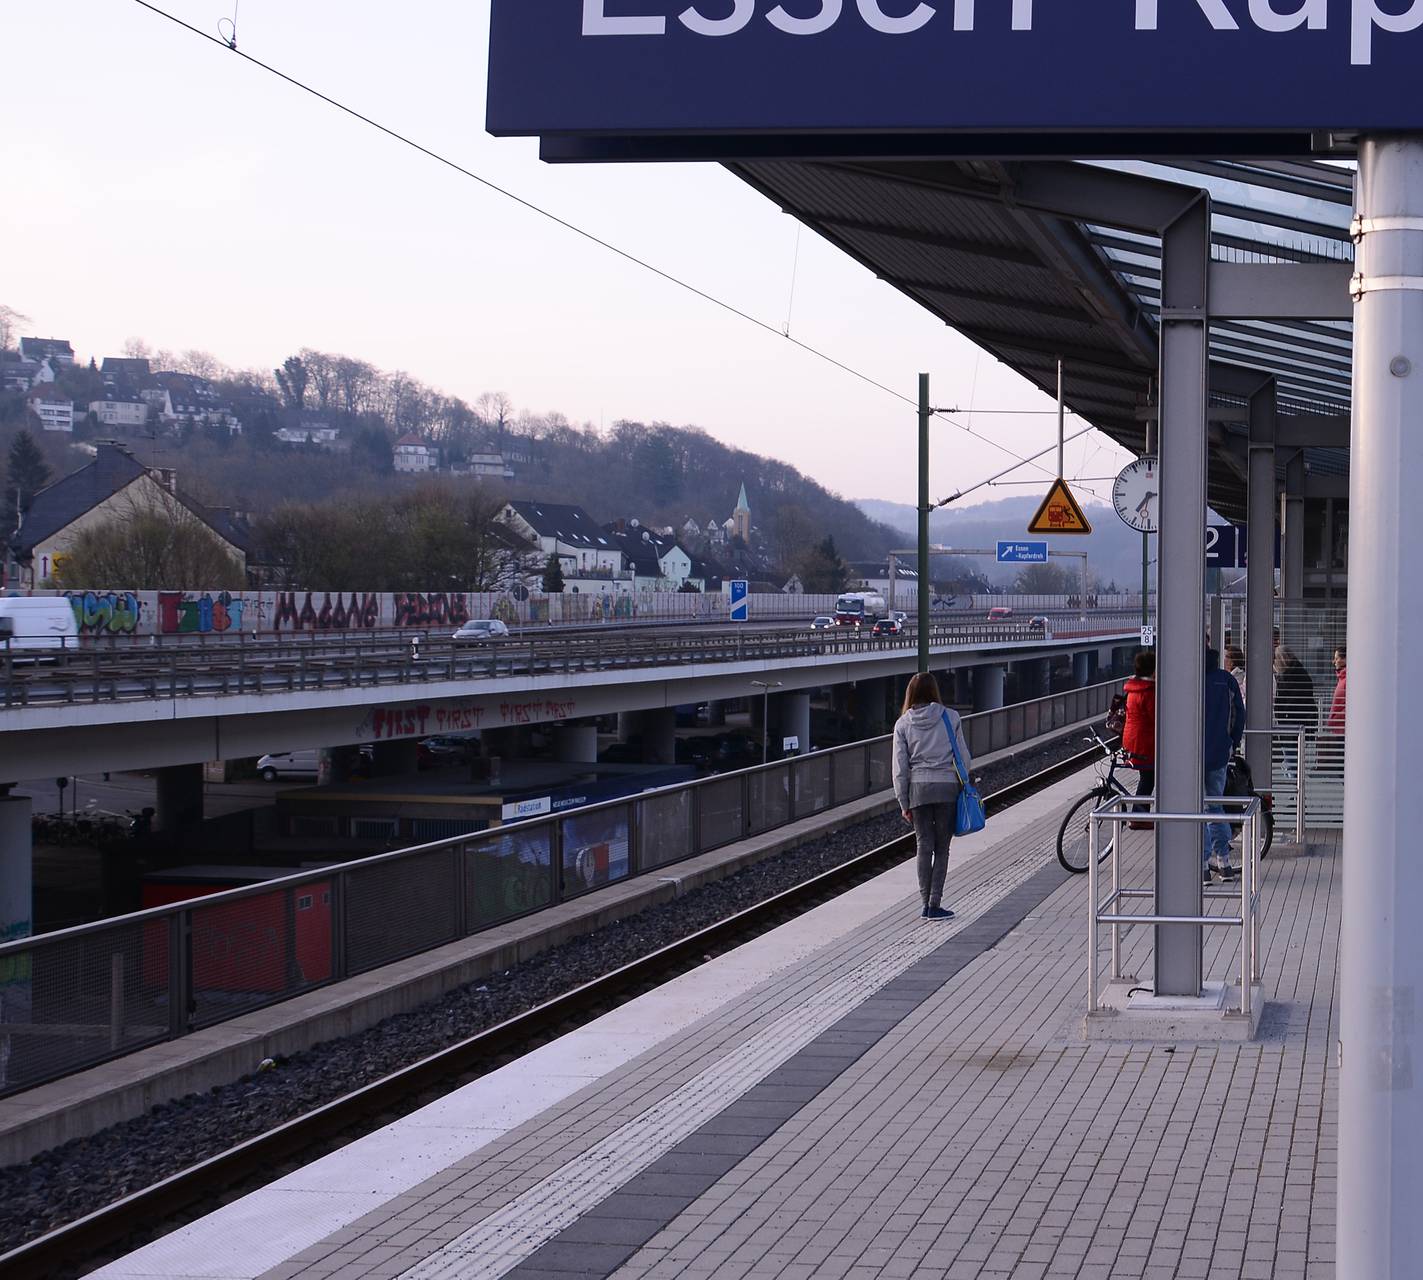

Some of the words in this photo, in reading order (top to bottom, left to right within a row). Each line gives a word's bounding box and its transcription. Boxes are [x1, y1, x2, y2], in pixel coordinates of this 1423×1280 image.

[1206, 527, 1219, 558] 2
[1142, 626, 1152, 636] 25
[1144, 635, 1150, 644] 8
